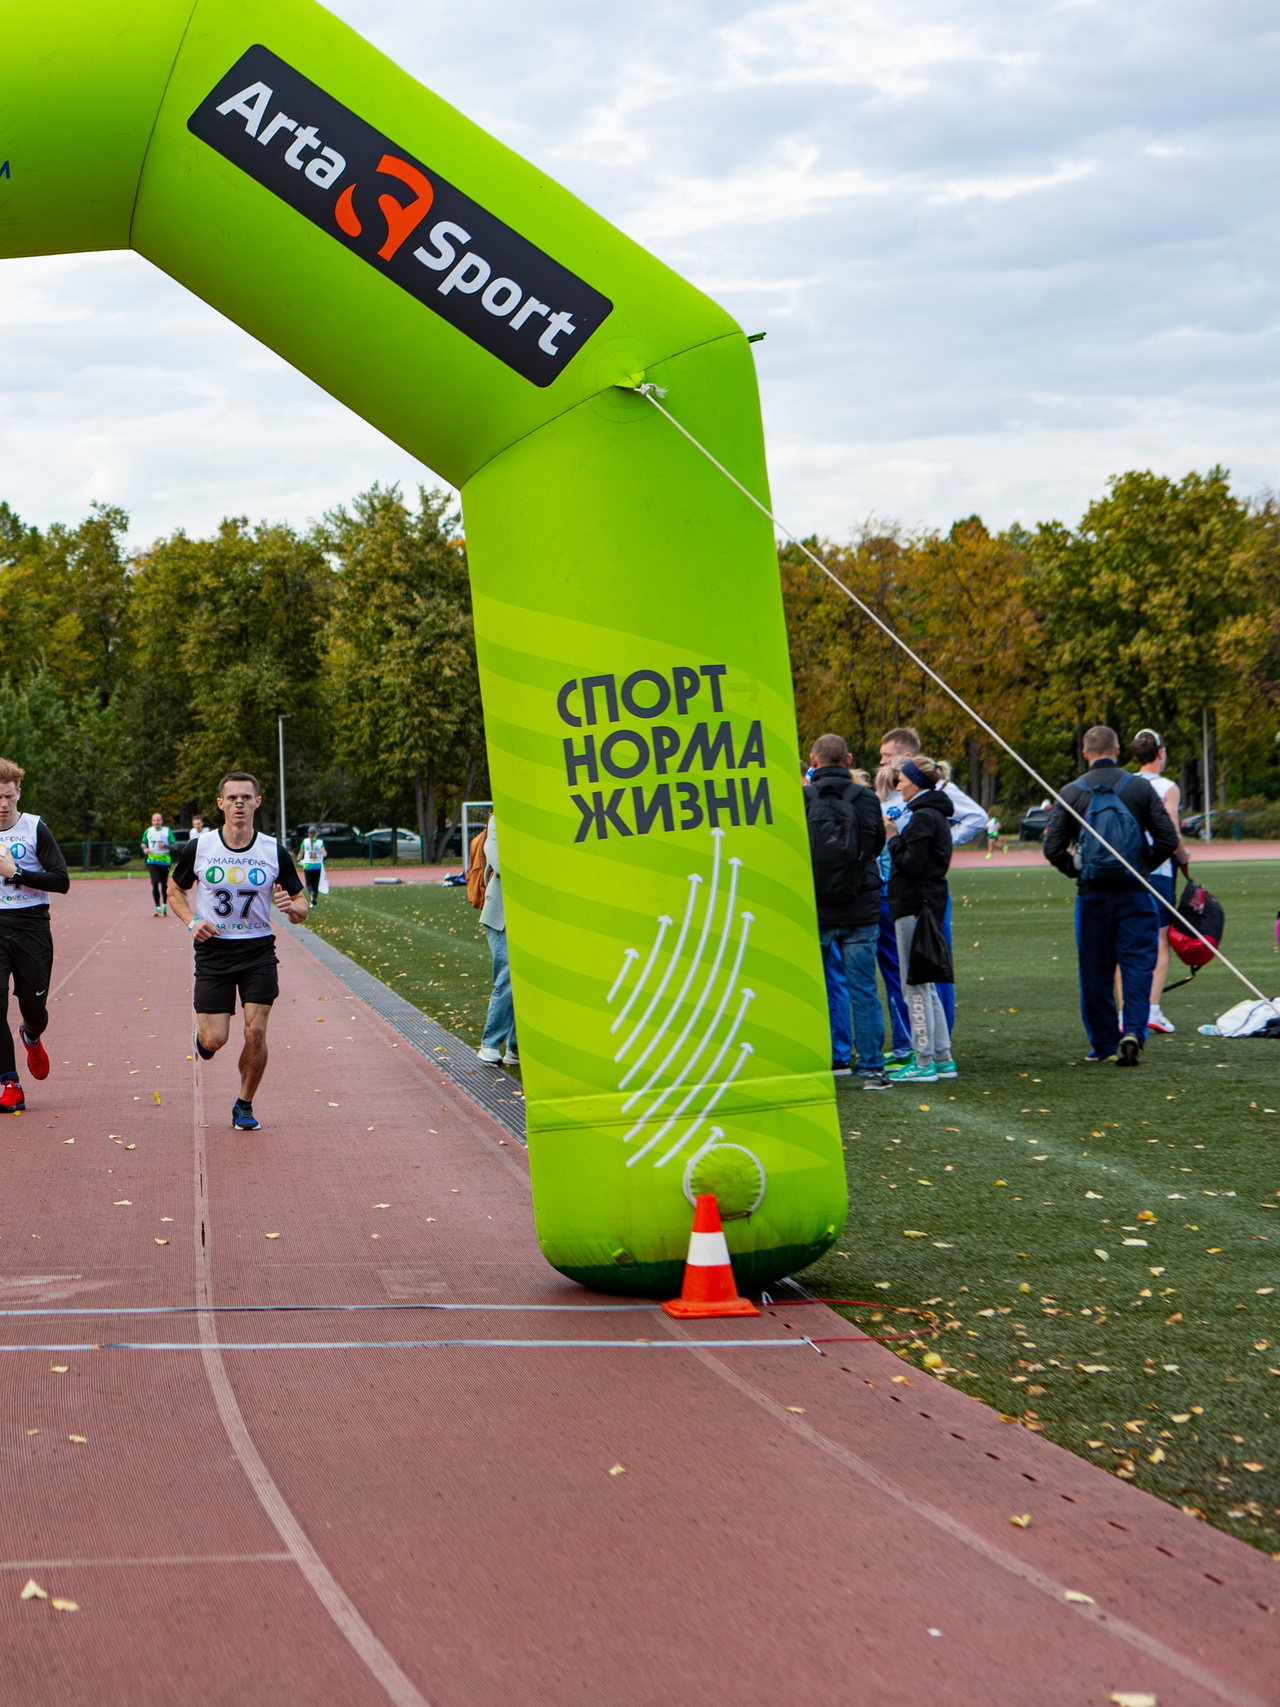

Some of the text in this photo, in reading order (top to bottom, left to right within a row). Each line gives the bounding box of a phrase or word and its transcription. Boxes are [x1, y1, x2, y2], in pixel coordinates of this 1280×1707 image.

[216, 81, 576, 356] Arta Sport
[557, 664, 727, 728] СПОРТ
[562, 720, 766, 786] НОРМА
[570, 777, 773, 844] ЖИЗНИ
[207, 857, 266, 867] VMARAFONE
[213, 888, 259, 919] 37
[912, 994, 929, 1046] adidas
